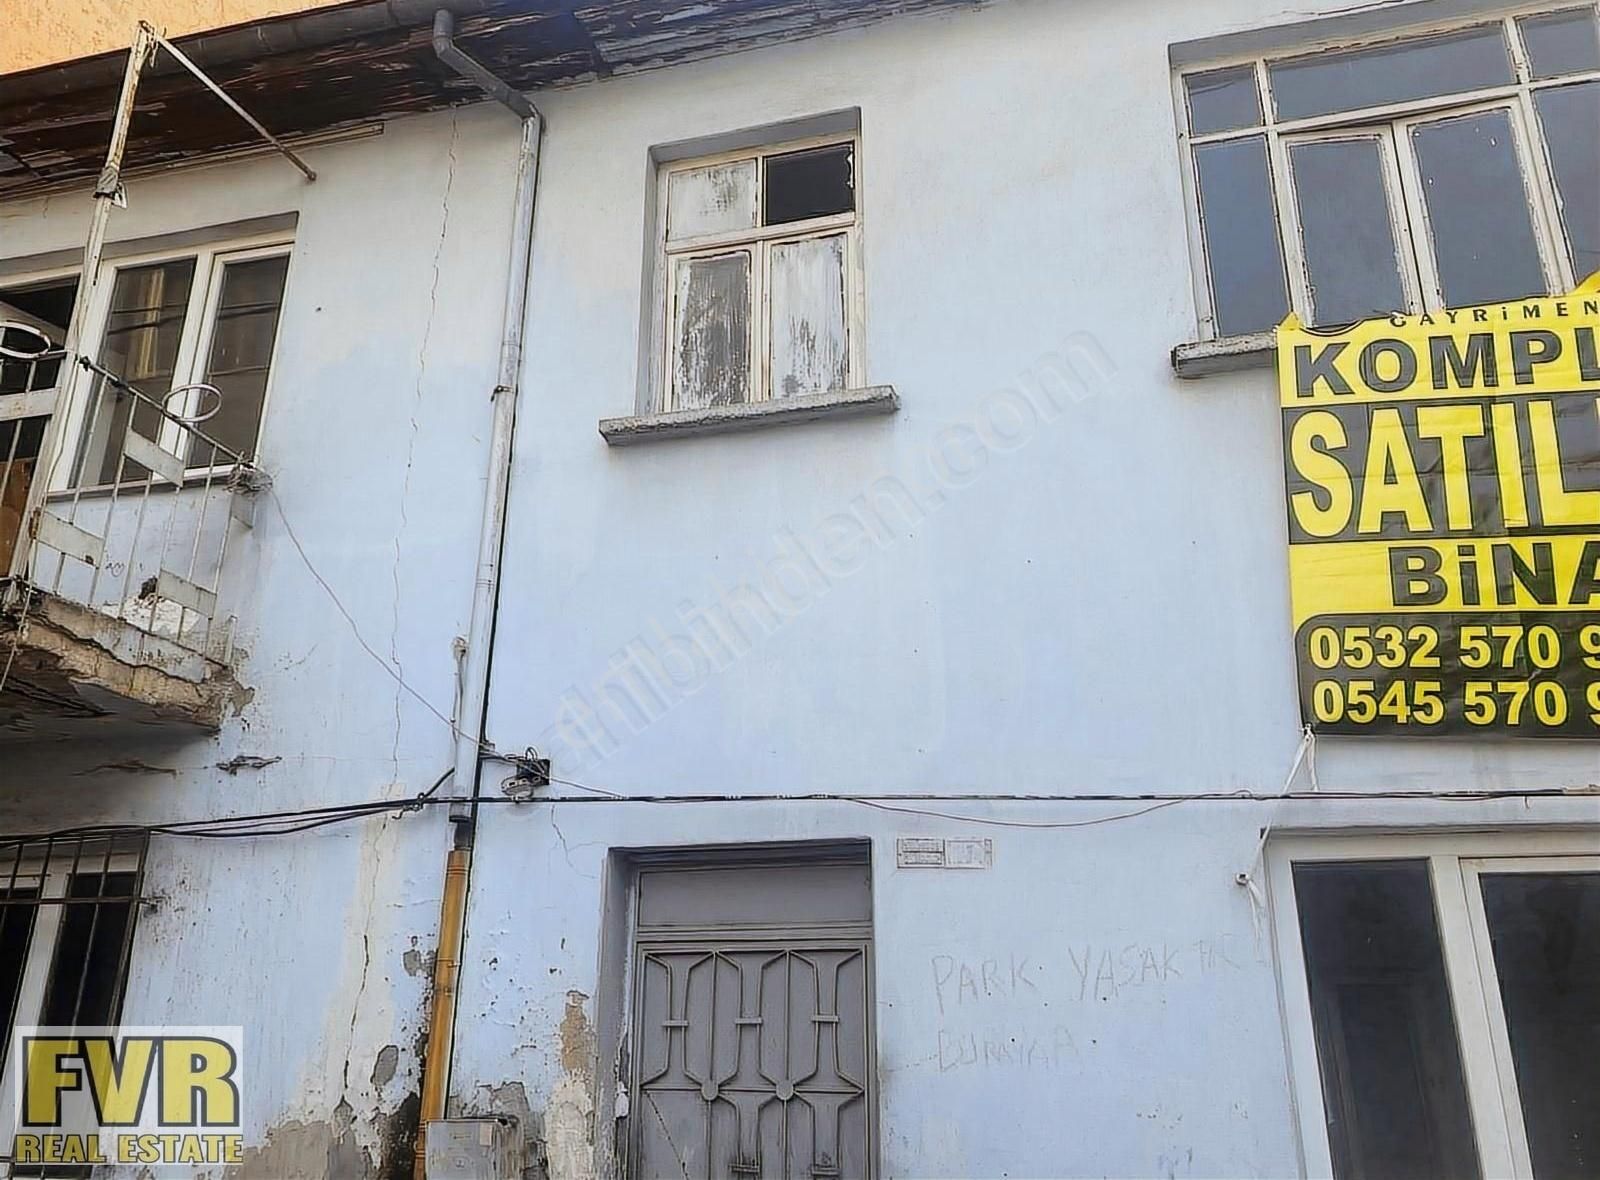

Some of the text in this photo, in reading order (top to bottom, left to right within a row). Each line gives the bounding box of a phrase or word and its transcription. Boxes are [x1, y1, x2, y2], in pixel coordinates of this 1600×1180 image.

[1293, 327, 1600, 398] KOMPL
[1291, 400, 1600, 537] SATIL
[1310, 625, 1441, 669] 0532
[1458, 624, 1561, 669] 570
[1313, 680, 1445, 724] 0545
[1464, 680, 1568, 726] 570
[931, 953, 1037, 1015] PARK
[1068, 944, 1182, 1001] YASAK
